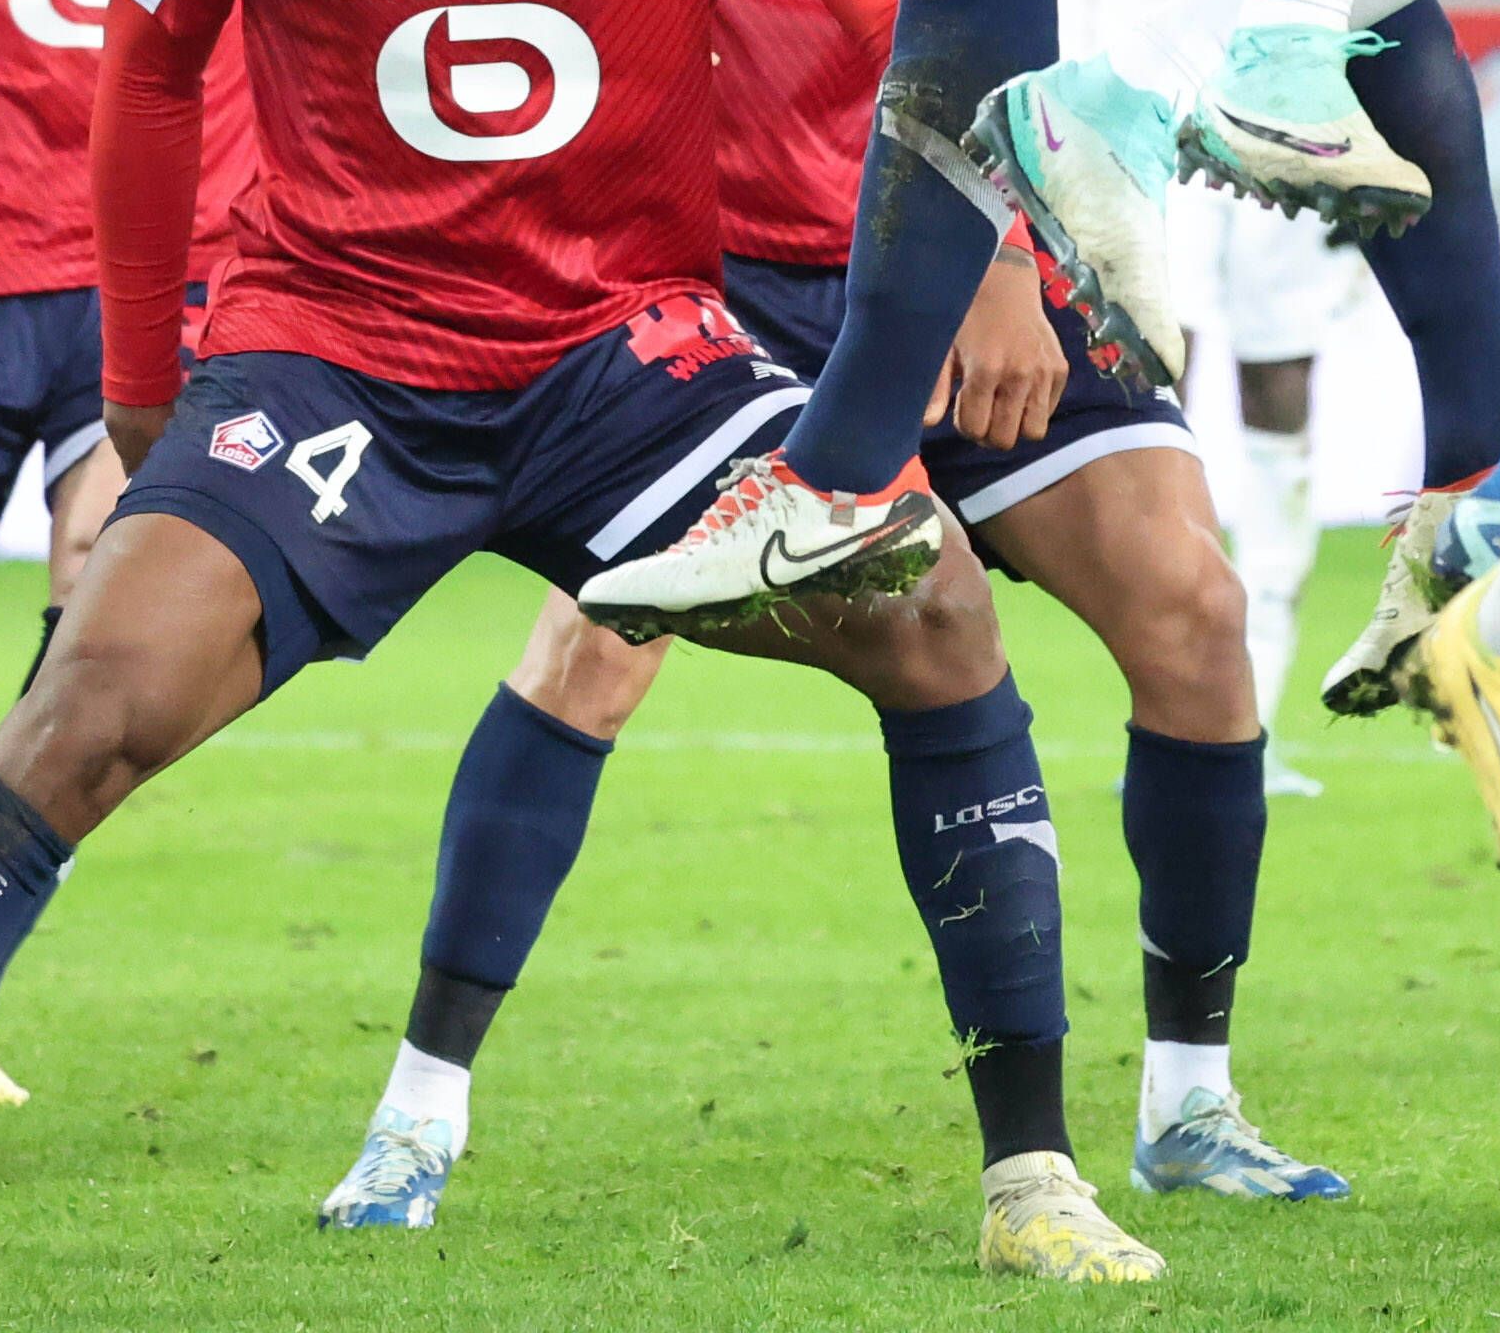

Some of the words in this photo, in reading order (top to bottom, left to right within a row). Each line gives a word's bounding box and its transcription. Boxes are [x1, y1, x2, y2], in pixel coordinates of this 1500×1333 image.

[213, 444, 256, 465] LOSC
[284, 419, 374, 525] 4
[933, 784, 1045, 833] LOSC
